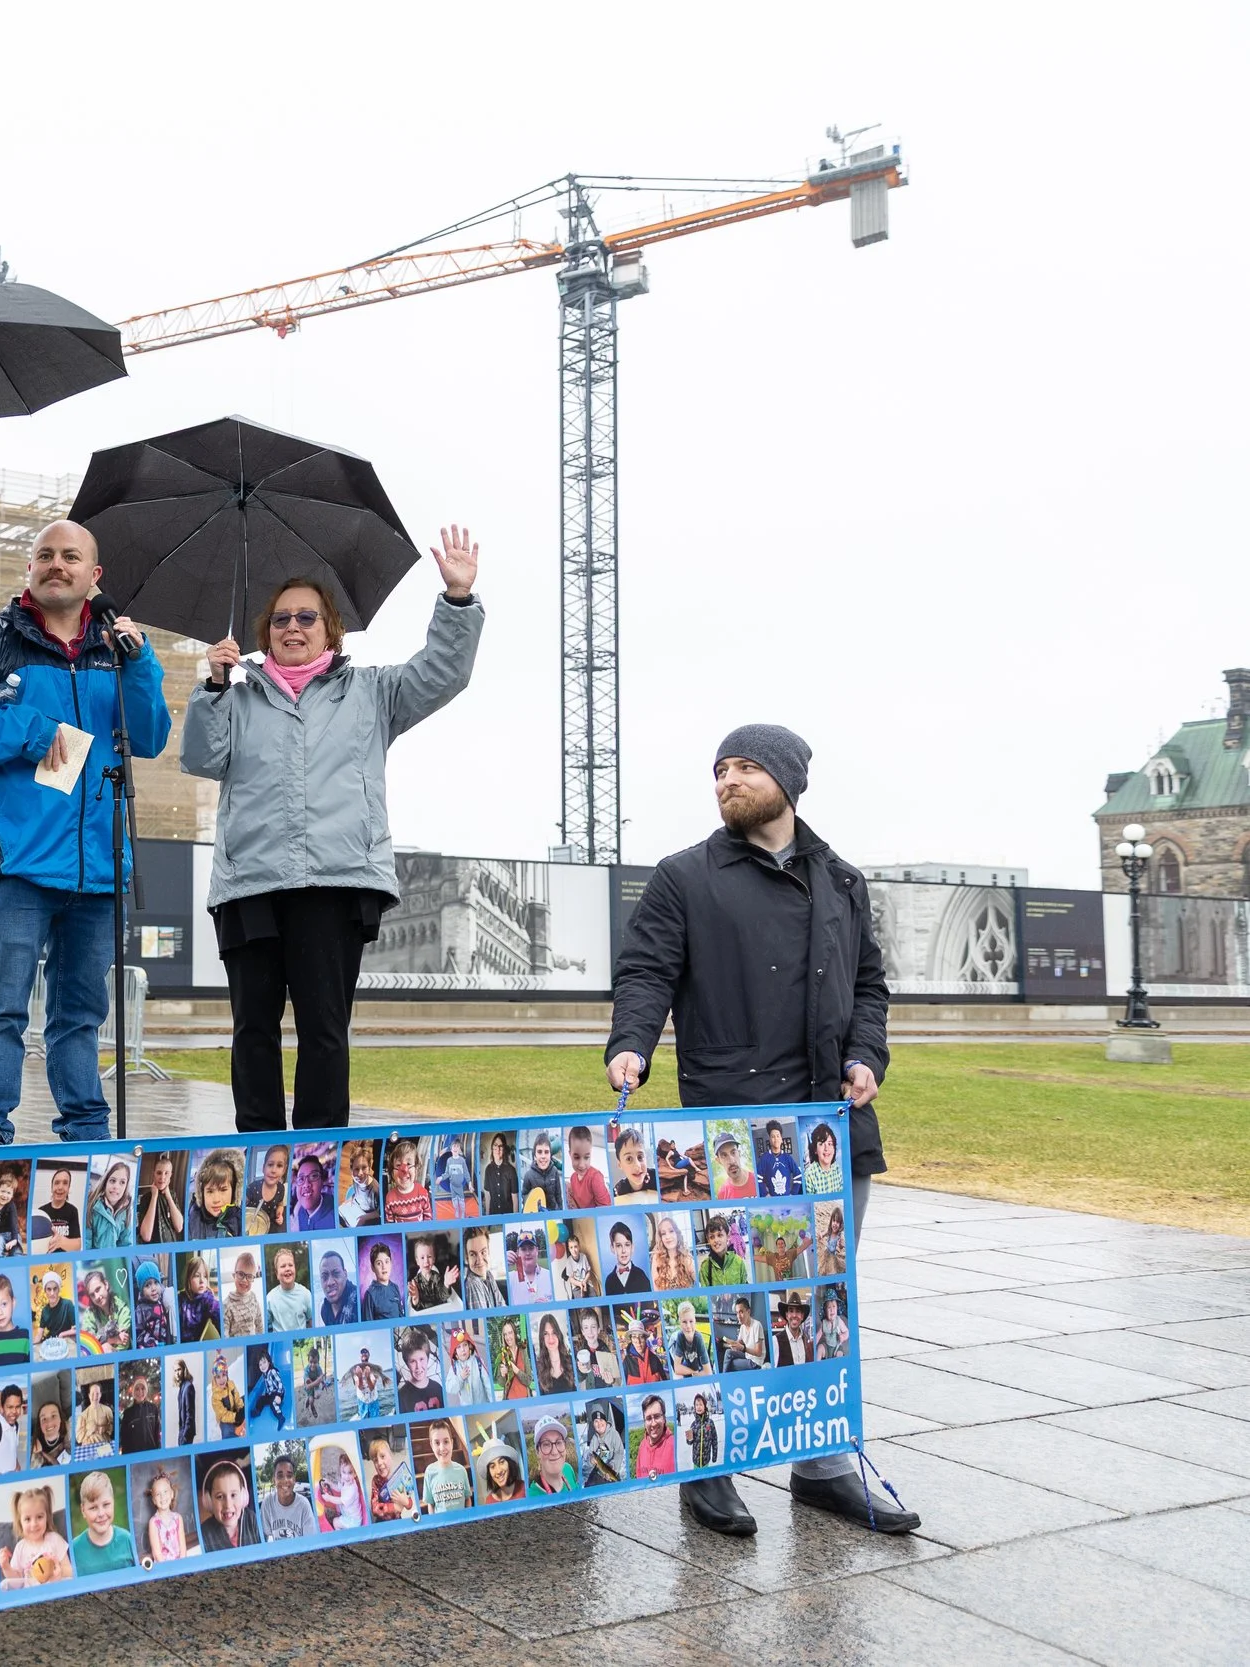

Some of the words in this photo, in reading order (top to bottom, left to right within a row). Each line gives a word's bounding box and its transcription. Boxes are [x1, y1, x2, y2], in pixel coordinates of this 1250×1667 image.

[750, 1385, 818, 1421] Faces
[825, 1367, 848, 1407] of
[727, 1387, 749, 1463] 2026
[751, 1409, 851, 1460] Autism
